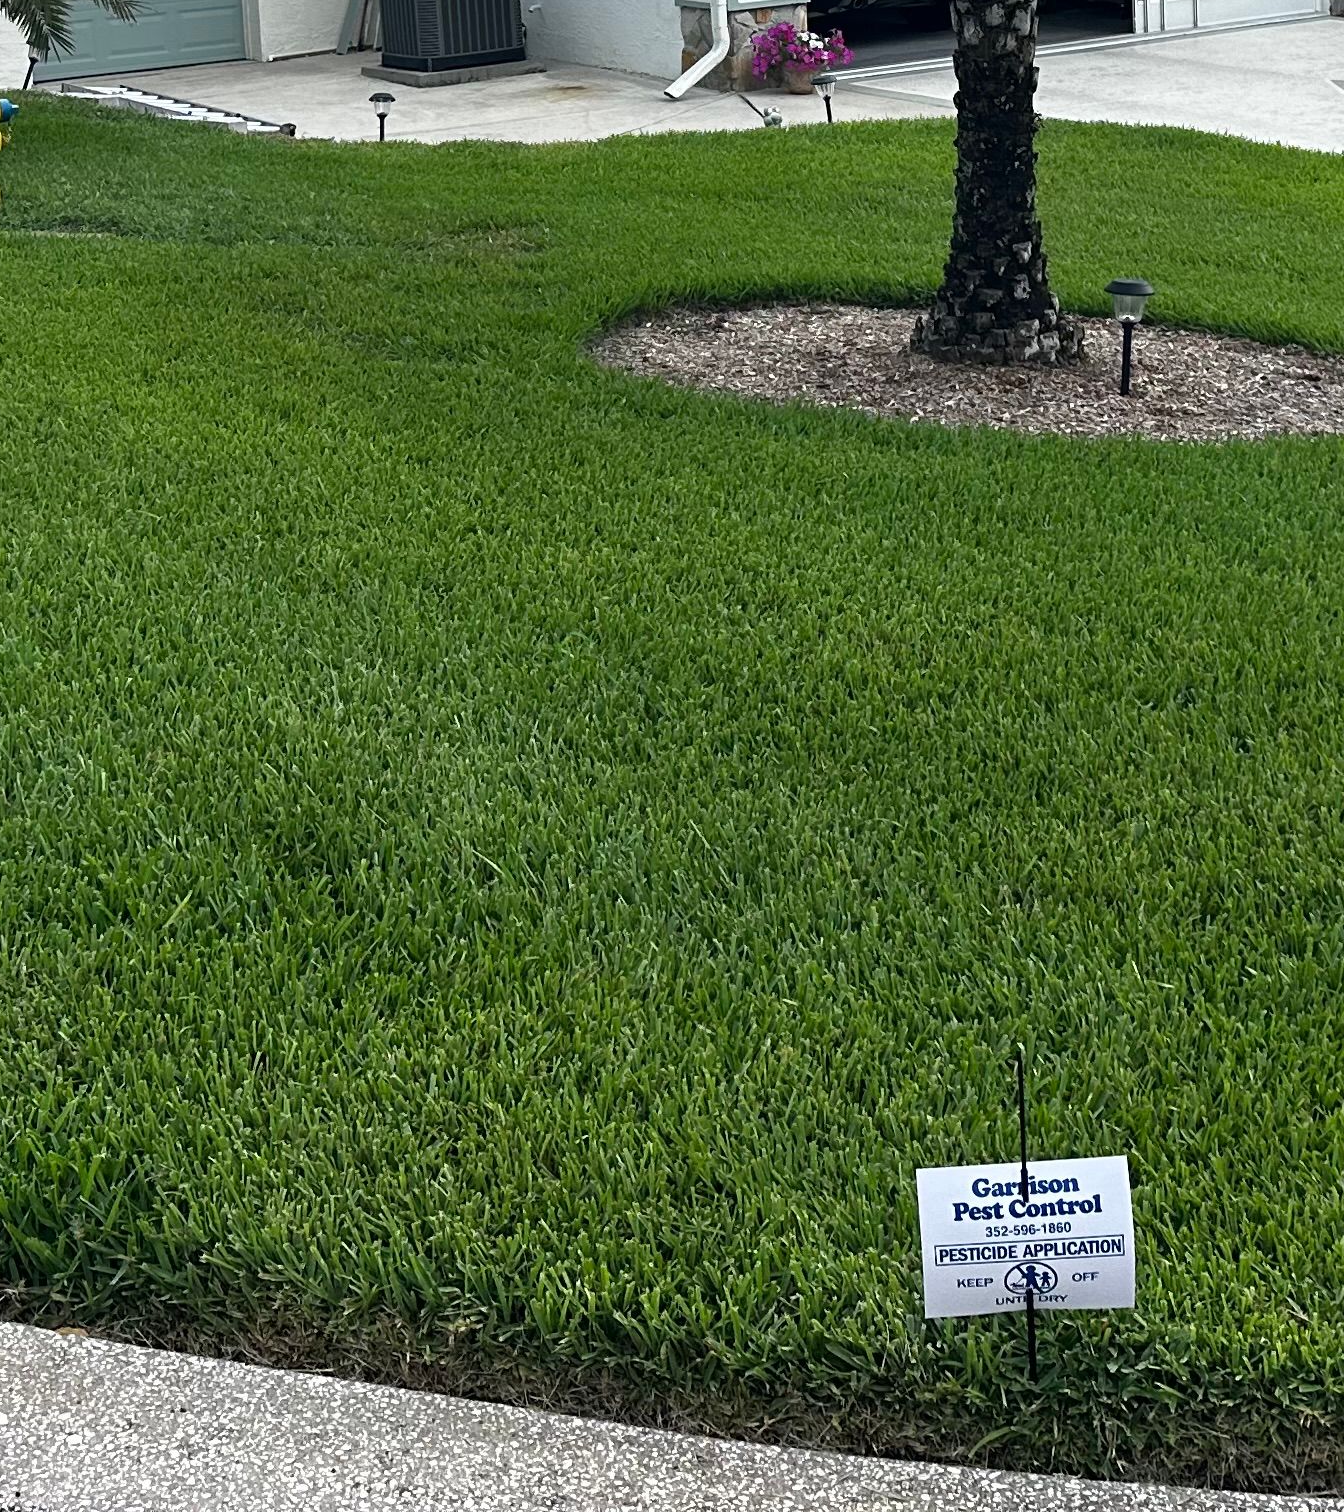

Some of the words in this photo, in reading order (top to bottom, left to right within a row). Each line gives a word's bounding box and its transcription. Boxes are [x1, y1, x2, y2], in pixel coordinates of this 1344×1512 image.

[952, 1201, 1004, 1222] Pest
[1008, 1194, 1103, 1219] Control
[985, 1221, 1072, 1238] 352-596-1860
[939, 1244, 1018, 1263] PESTICIDE
[1023, 1238, 1122, 1258] APPLICATION
[957, 1277, 994, 1288] KEEP
[1071, 1271, 1099, 1282] OFF
[995, 1294, 1033, 1306] UNTI
[1038, 1294, 1069, 1303] DRY
